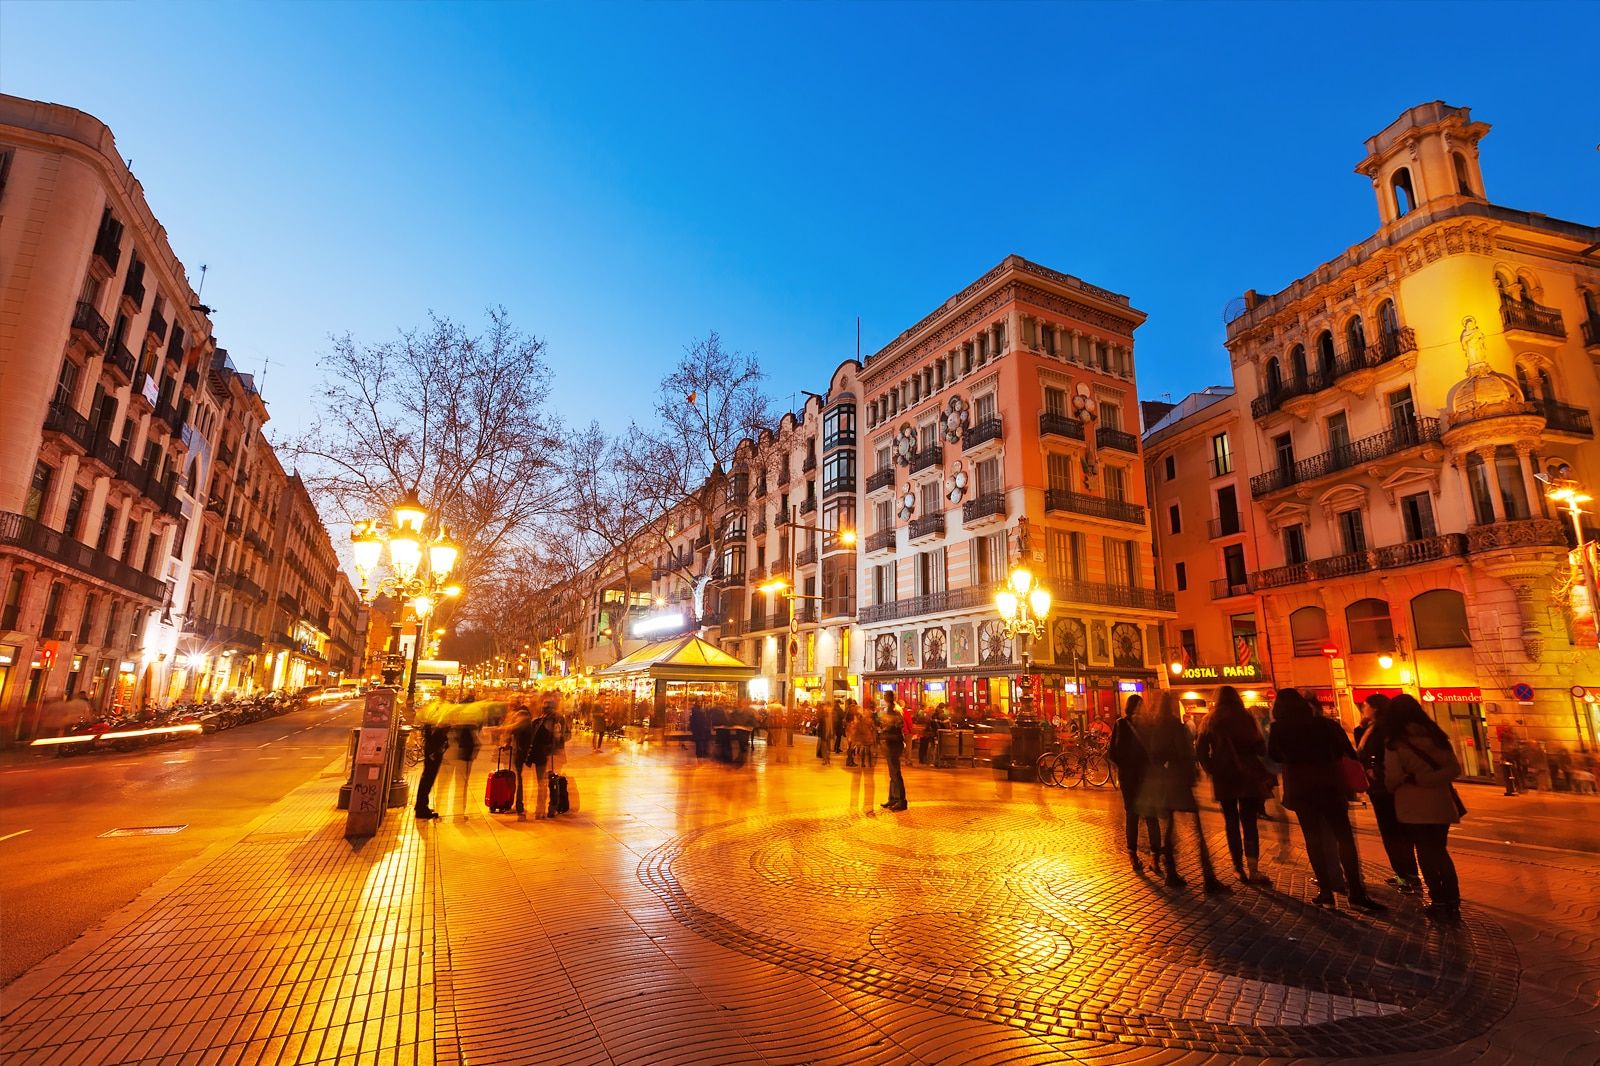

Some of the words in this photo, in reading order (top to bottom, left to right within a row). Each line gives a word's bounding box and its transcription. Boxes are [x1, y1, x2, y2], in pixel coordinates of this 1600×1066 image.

[1182, 668, 1218, 678] HOSTAL
[1223, 665, 1255, 677] PARIS
[1437, 692, 1482, 702] Santander
